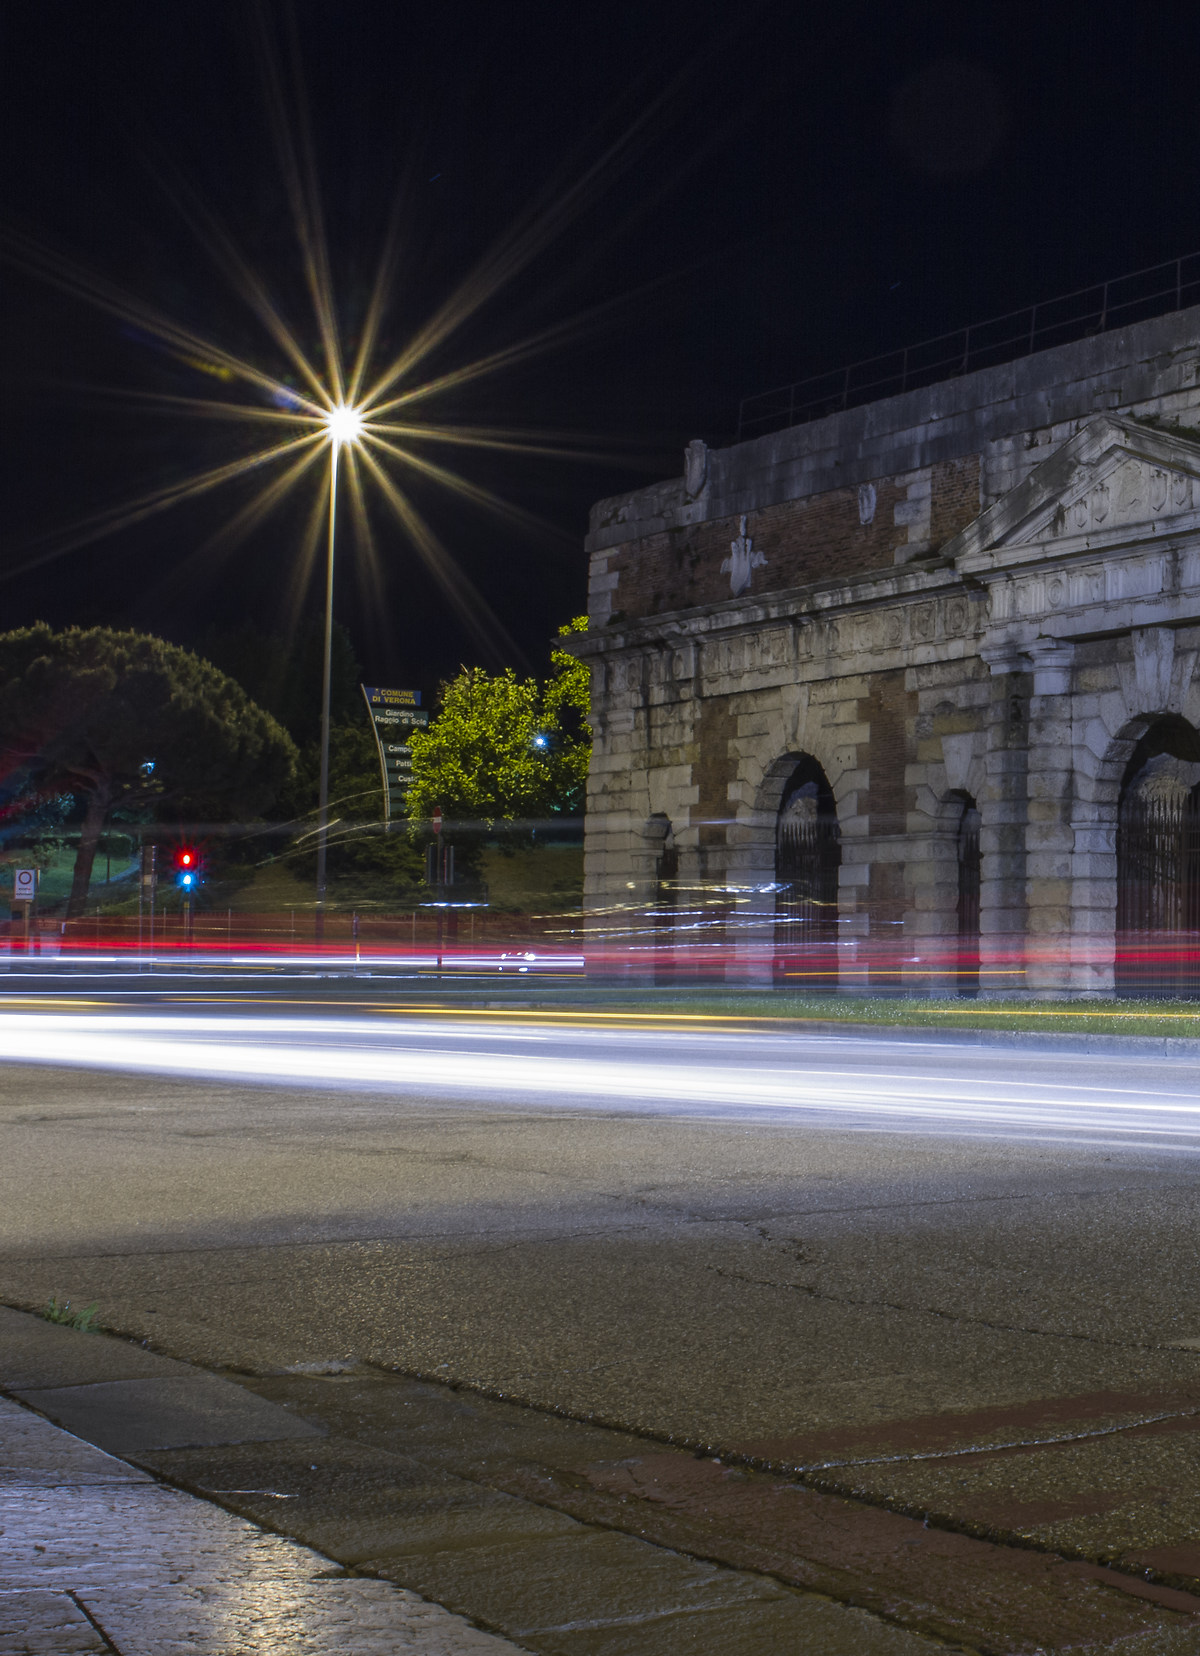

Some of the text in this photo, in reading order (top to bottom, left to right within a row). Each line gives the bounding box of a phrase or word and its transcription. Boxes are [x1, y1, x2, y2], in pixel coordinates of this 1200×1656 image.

[381, 689, 414, 698] COMUNE
[384, 696, 416, 705] VERONA
[385, 709, 415, 718] Giardino
[375, 715, 400, 724] Raggio
[411, 717, 427, 726] Sole
